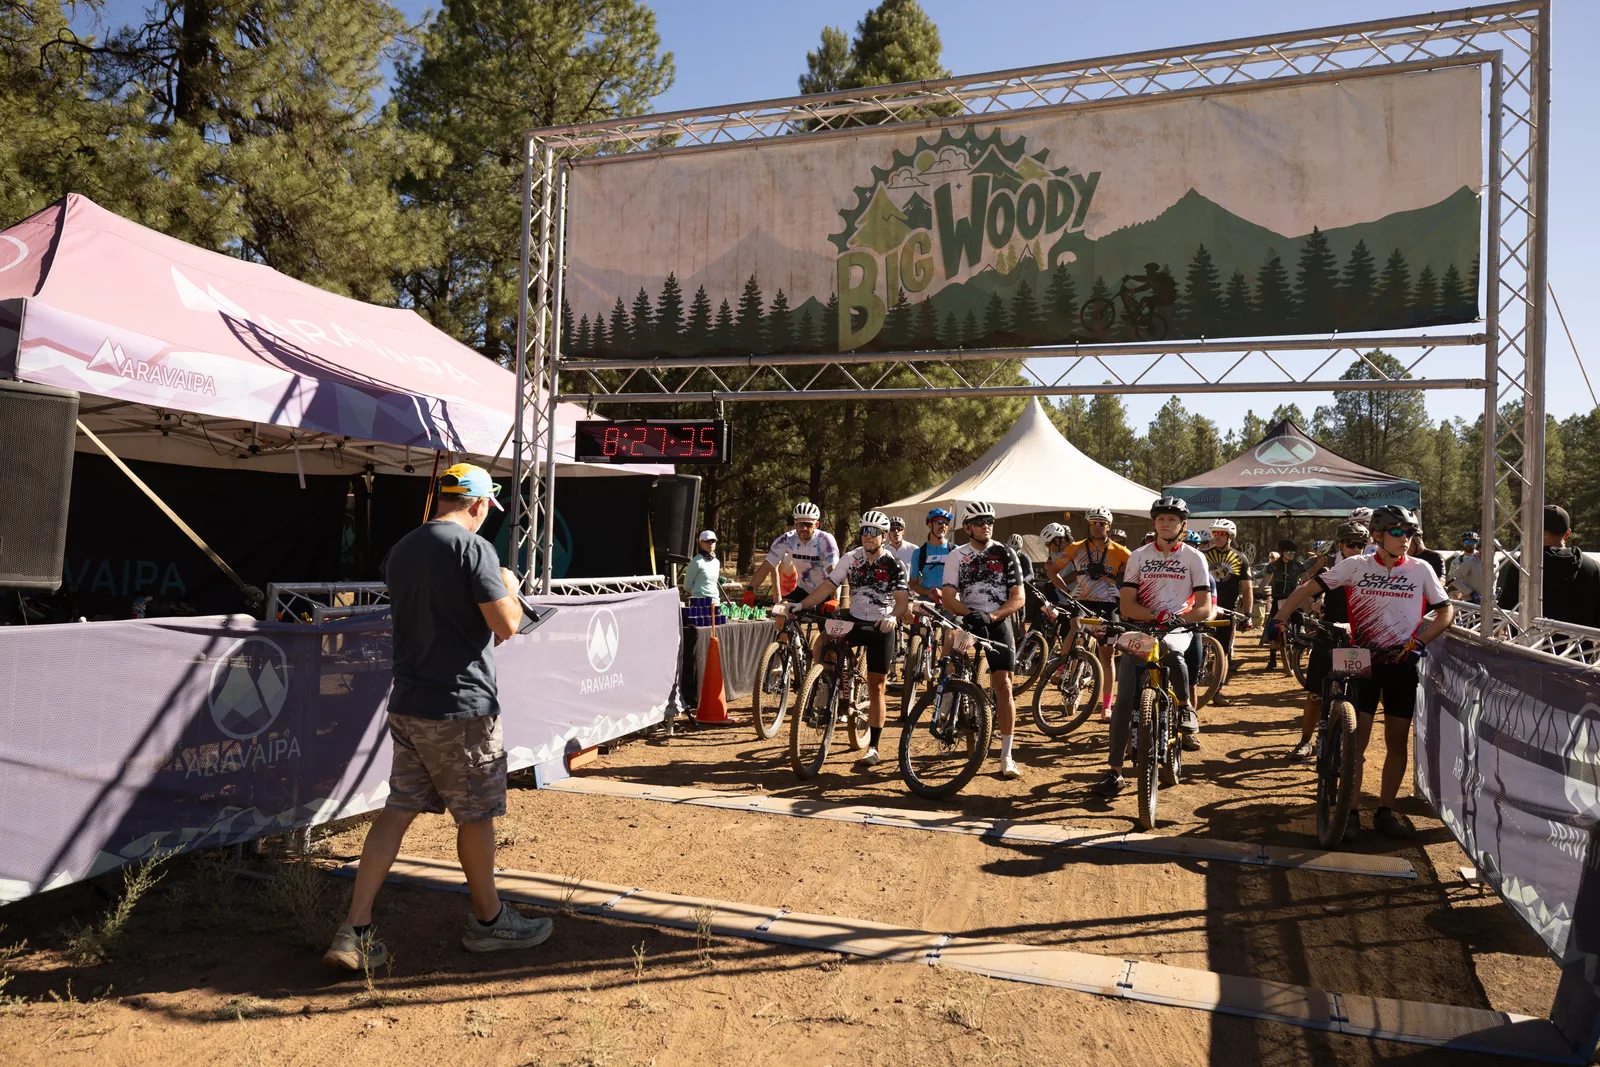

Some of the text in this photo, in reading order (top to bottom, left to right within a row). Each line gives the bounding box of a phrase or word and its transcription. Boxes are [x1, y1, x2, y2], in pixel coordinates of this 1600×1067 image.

[837, 171, 1102, 351] BIG WOODY
[120, 359, 217, 396] ARAVAIPA
[1240, 466, 1330, 476] ARAVAIPA
[1141, 564, 1188, 574] OnTrack
[64, 558, 187, 596] VAIPA
[1143, 573, 1186, 581] Composite
[1357, 580, 1417, 592] OnTrack
[1360, 588, 1414, 599] Composite
[830, 626, 844, 635] 127
[1127, 640, 1142, 651] 119
[1343, 660, 1362, 670] 120
[579, 672, 624, 695] ARAVAIPA
[185, 736, 302, 780] ARAVAIPA
[492, 928, 517, 939] HOKA
